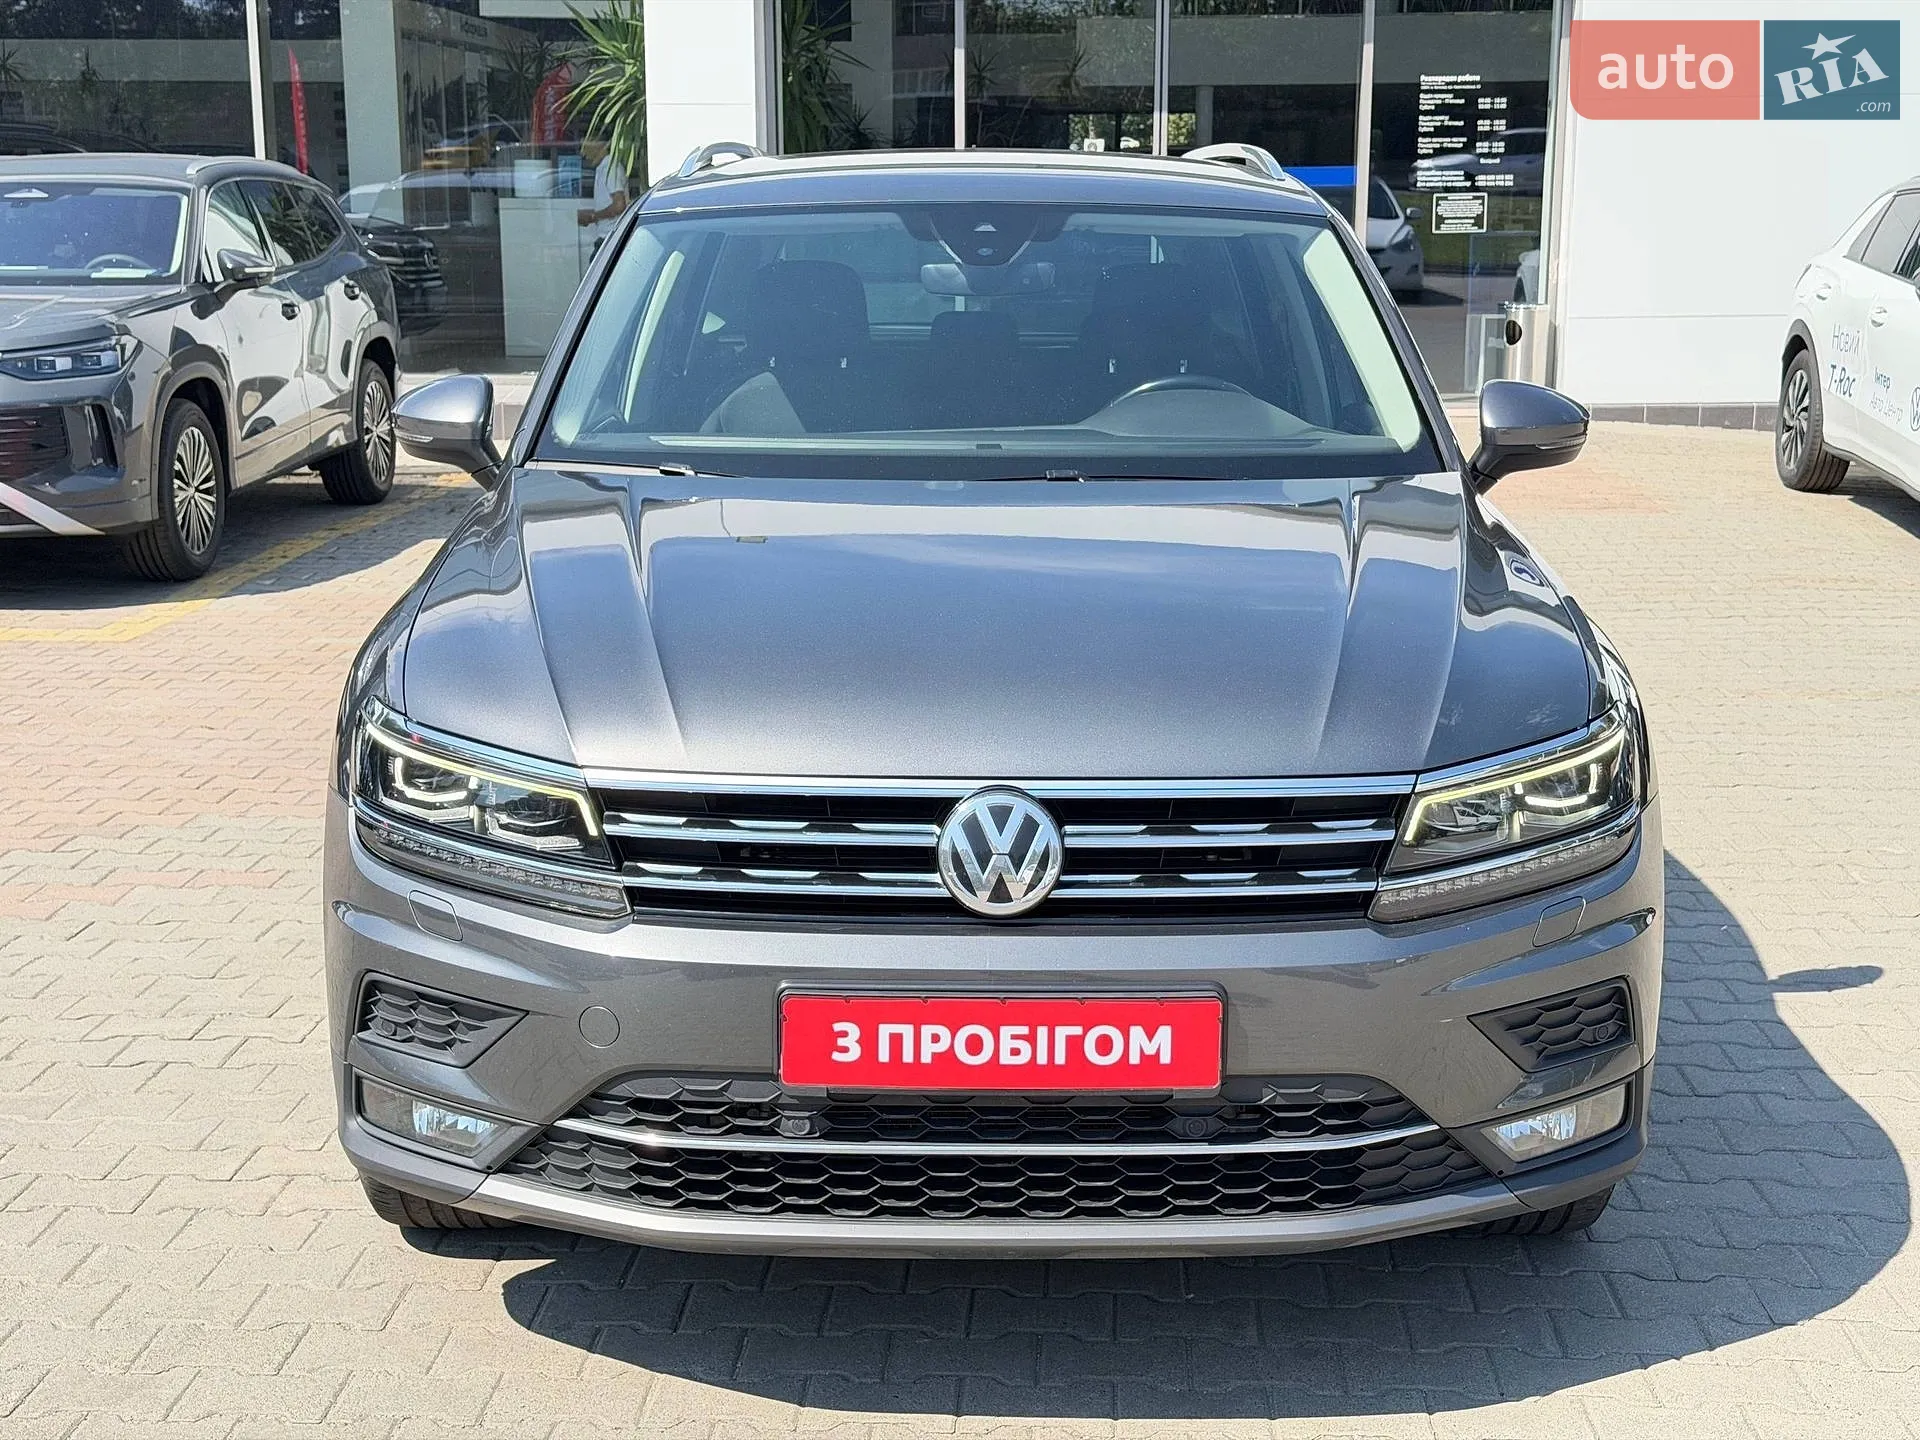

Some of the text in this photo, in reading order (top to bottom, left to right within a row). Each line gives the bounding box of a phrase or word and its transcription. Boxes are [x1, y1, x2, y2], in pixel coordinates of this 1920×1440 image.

[1831, 323, 1861, 356] Новий
[830, 1022, 1172, 1066] З ПРОБІГОМ
